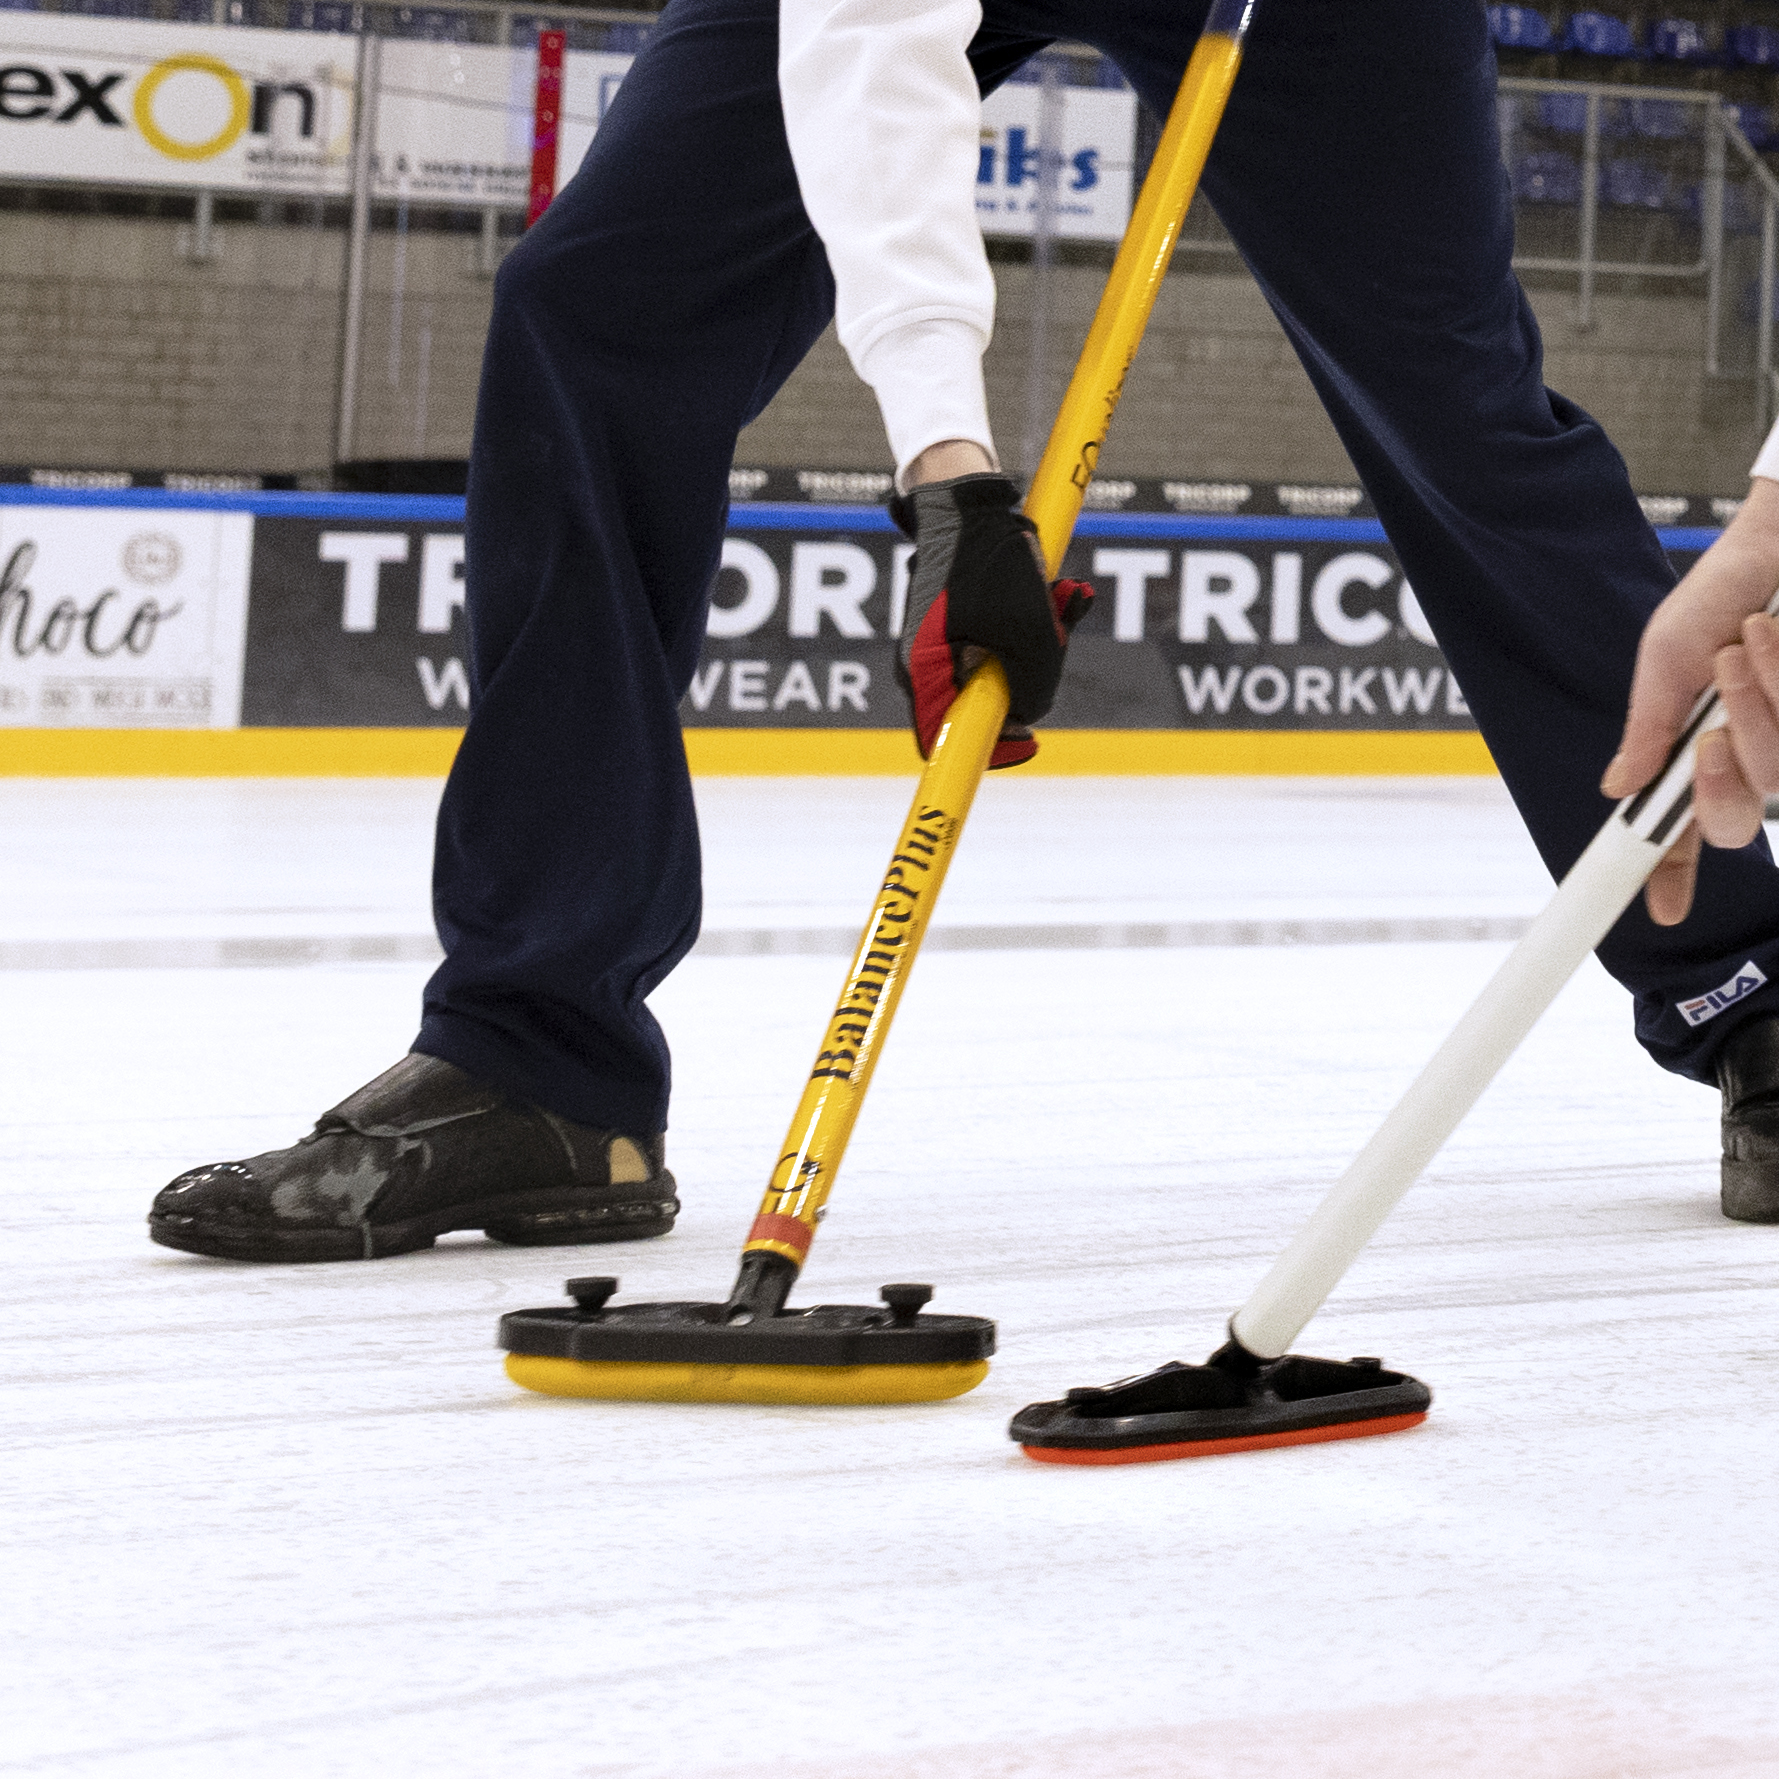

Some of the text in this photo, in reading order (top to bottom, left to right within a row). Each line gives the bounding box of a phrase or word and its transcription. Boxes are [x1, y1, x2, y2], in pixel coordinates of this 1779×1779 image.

[1093, 548, 1440, 647] TRIC
[811, 805, 946, 1081] BalancePlus
[1683, 975, 1760, 1023] FILA
